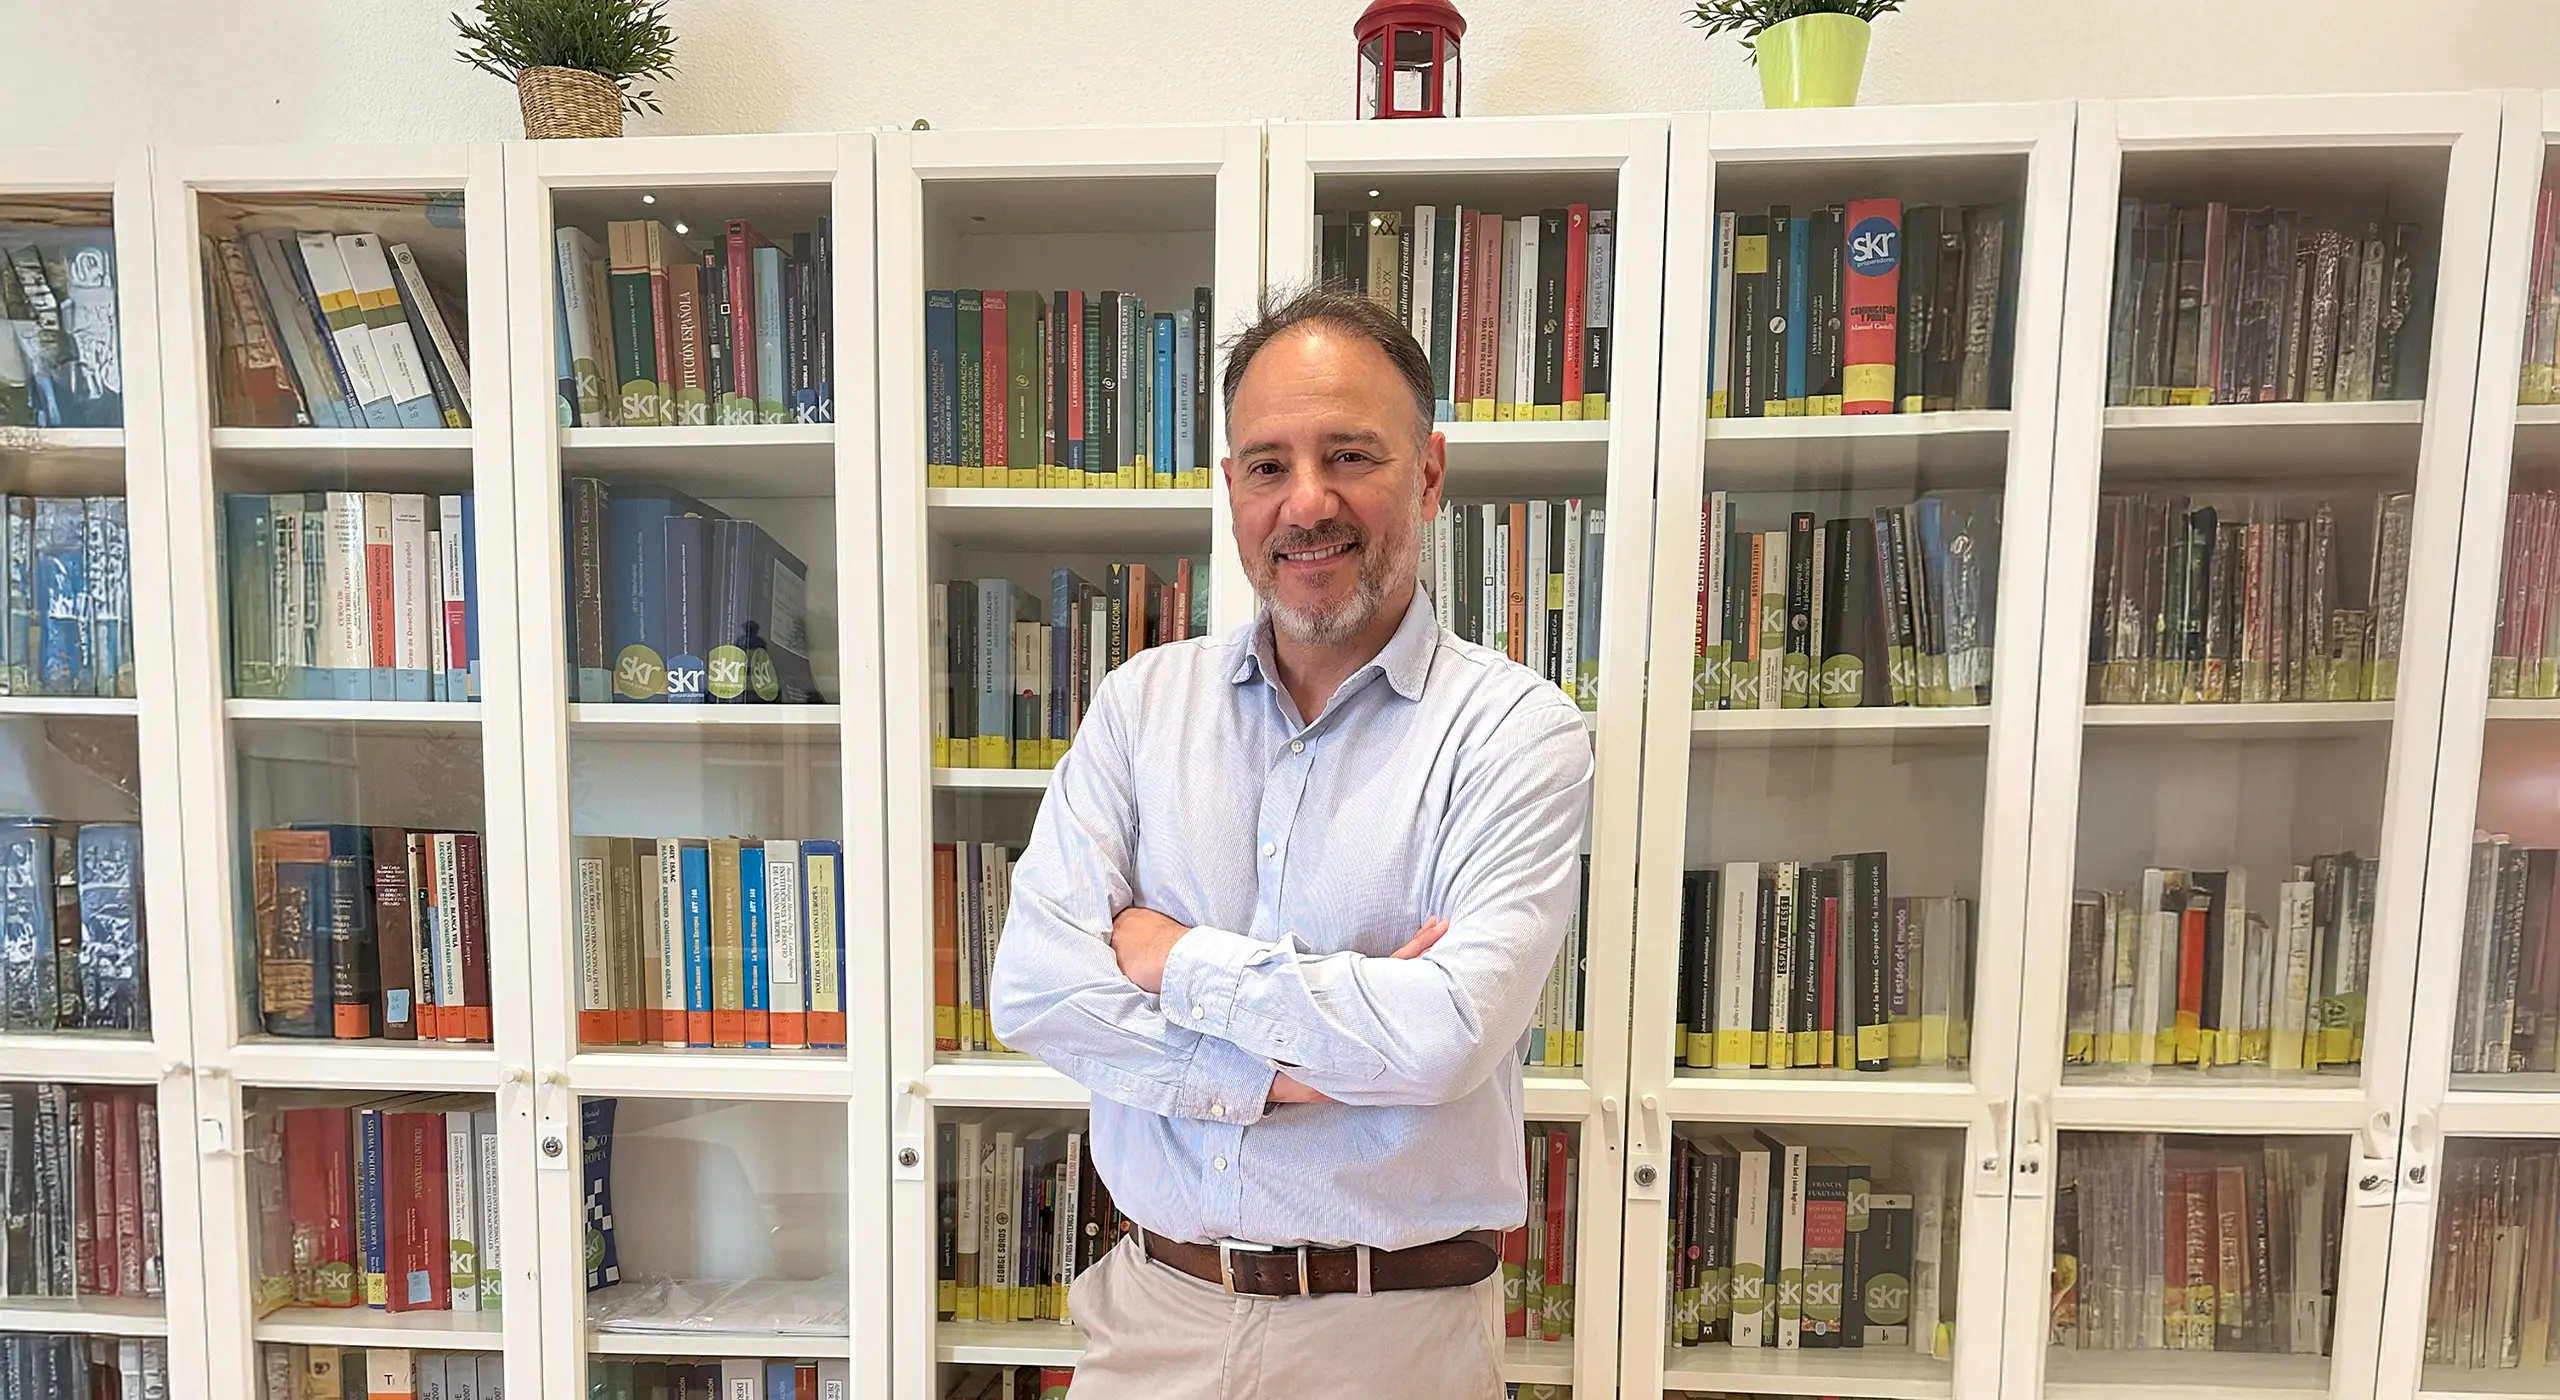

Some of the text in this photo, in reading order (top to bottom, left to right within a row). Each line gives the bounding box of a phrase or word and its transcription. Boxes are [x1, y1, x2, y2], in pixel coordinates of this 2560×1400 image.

[1463, 223, 1471, 252] ESPAÑA
[1854, 232, 1895, 261] skr
[1596, 246, 1603, 257] XX
[1595, 257, 1603, 280] SIGLO
[1462, 281, 1470, 320] INFORME
[1850, 305, 1896, 316] COMUNICACIÓN
[1850, 323, 1873, 331] Manuel
[1480, 363, 1486, 371] LA
[1486, 368, 1492, 376] LA
[931, 350, 939, 412] INFORMACIÓN
[622, 394, 657, 419] skr
[974, 402, 979, 410] LA
[932, 417, 939, 427] LA
[974, 413, 979, 422] DE
[932, 432, 939, 442] DE
[998, 434, 1003, 443] DE
[975, 450, 980, 459] EL
[1893, 514, 1903, 543] sombra
[581, 484, 590, 597] Hacienda Pública Española
[1895, 544, 1904, 554] su
[1568, 539, 1576, 597] globalización?
[1896, 561, 1907, 593] política
[1442, 583, 1447, 591] Un
[1751, 563, 1759, 597] FERGUSON
[1899, 594, 1908, 605] La
[1112, 599, 1120, 646] CIVILIZACIONES
[1567, 612, 1574, 620] es
[407, 638, 413, 646] de
[987, 639, 992, 647] LA
[1112, 647, 1120, 655] DE
[619, 656, 661, 685] skr
[667, 667, 704, 693] skr
[709, 657, 745, 684] skr
[987, 685, 992, 693] EN
[1822, 667, 1863, 695] skr
[772, 866, 779, 876] DE
[441, 877, 447, 885] DE
[773, 877, 779, 887] LA
[1810, 877, 1818, 908] expertos
[973, 931, 978, 939] UN
[1809, 921, 1816, 930] de
[814, 940, 820, 948] LA
[1808, 932, 1816, 960] mundial
[814, 949, 820, 959] DE
[1894, 909, 1905, 1005] El estado del mundo
[1806, 962, 1814, 992] gobierno
[1806, 994, 1813, 1002] El
[368, 1150, 376, 1184] POLÍTICO
[1068, 1141, 1077, 1190] LEOPOLDO ABADÍA
[999, 1144, 1008, 1208] Tiempos inciertos
[1708, 1161, 1718, 1234] Estudios del malestar
[1066, 1214, 1074, 1243] MISTERIOS
[997, 1228, 1006, 1283] GEORGE SOROS
[1065, 1244, 1073, 1262] OTROS
[1707, 1245, 1715, 1266] Pardo
[1064, 1268, 1072, 1284] NINJA
[1806, 1280, 1842, 1306] skr
[1869, 1282, 1908, 1310] skr
